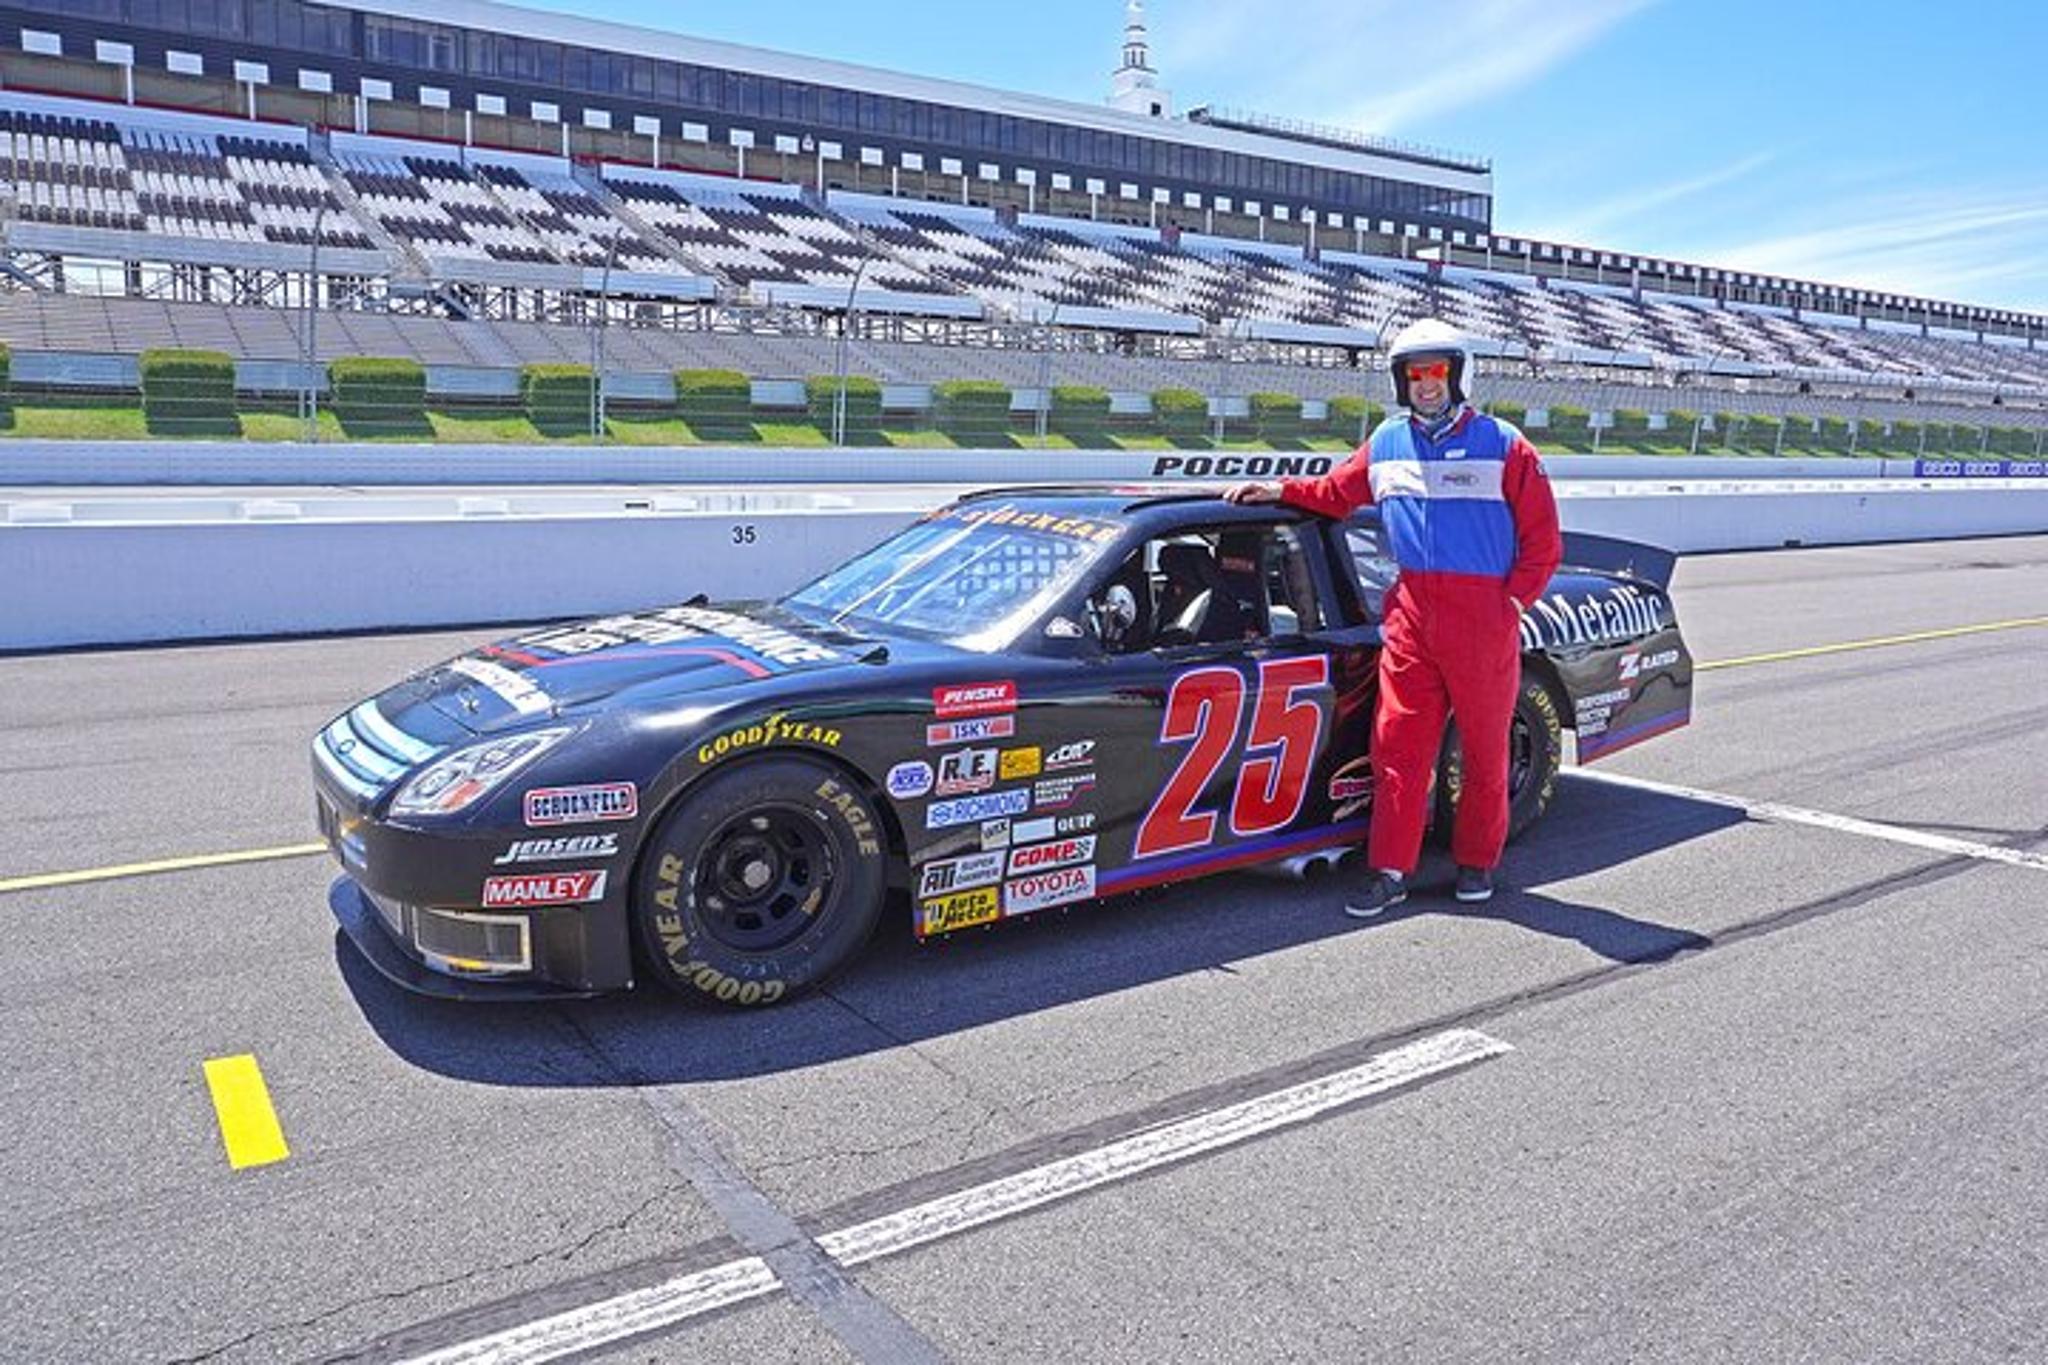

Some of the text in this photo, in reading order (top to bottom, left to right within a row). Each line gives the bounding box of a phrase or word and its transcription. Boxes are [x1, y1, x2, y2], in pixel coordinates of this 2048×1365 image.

[1152, 457, 1332, 476] POCONO
[732, 525, 756, 544] 35
[1534, 585, 1664, 646] Metallic
[943, 685, 1008, 704] PENSKE
[698, 711, 842, 764] GOODYEAR
[953, 721, 992, 739] ISKY
[1133, 653, 1329, 860] 25
[816, 779, 879, 857] EAGLE
[954, 792, 1028, 819] RICHMOND
[1013, 840, 1078, 868] COMP
[487, 876, 587, 904] MANLEY
[1008, 869, 1087, 899] TOYOTA
[654, 852, 786, 1004] GOODYEAR
